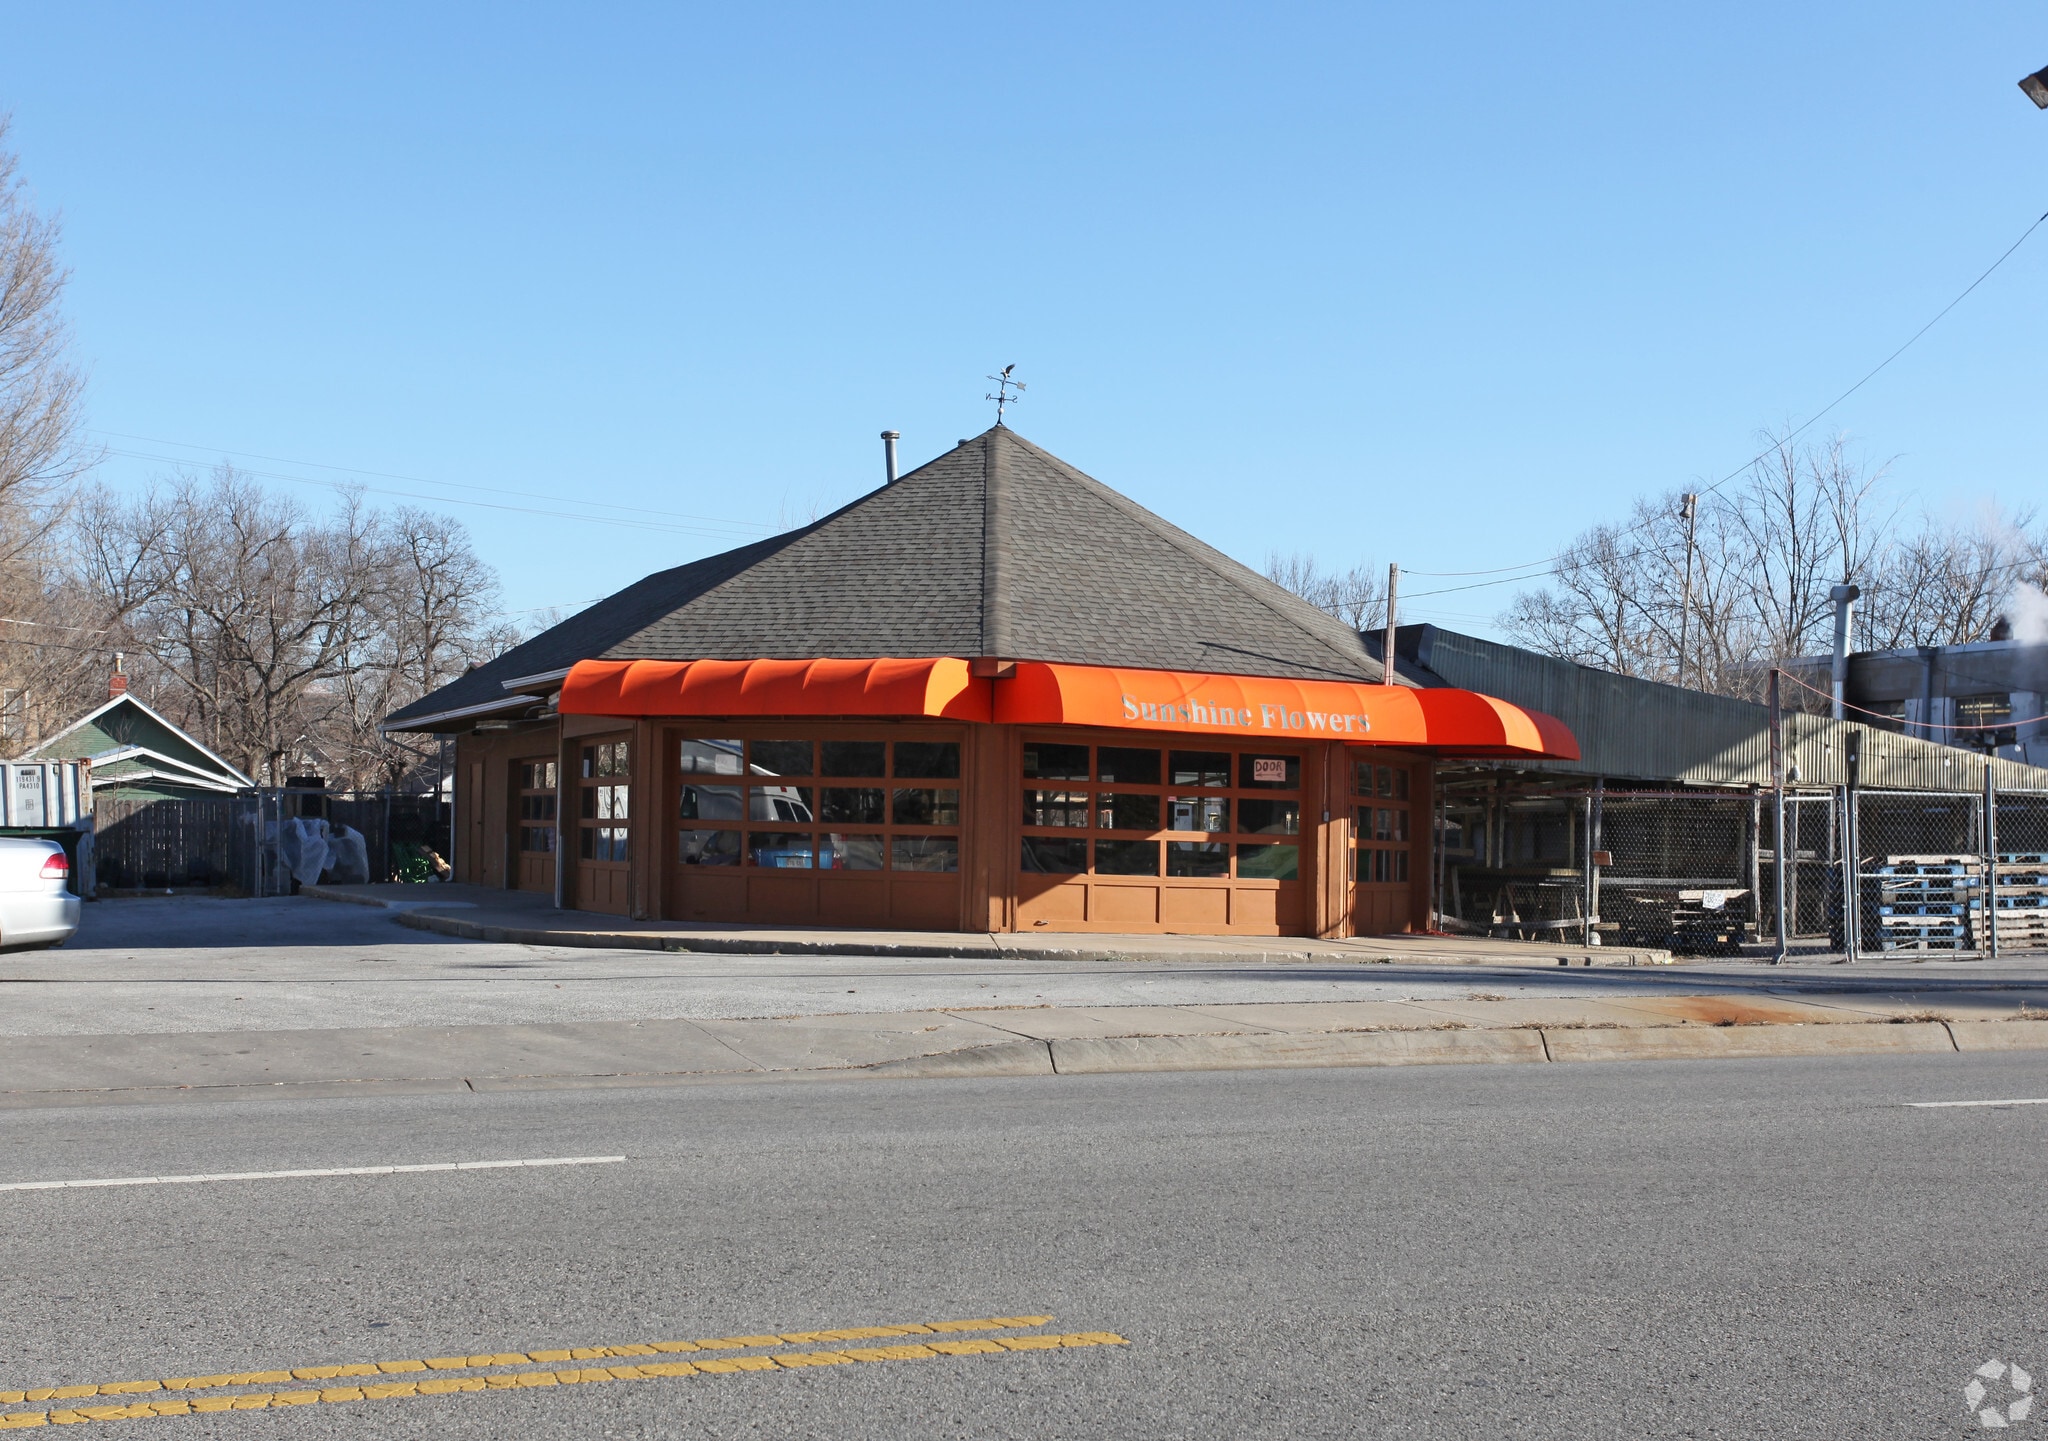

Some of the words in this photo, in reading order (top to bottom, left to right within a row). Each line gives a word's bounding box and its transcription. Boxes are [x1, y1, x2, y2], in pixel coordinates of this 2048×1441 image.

[1121, 693, 1253, 727] Sunshine
[1259, 703, 1371, 733] Flowers
[1255, 760, 1282, 772] DOOR
